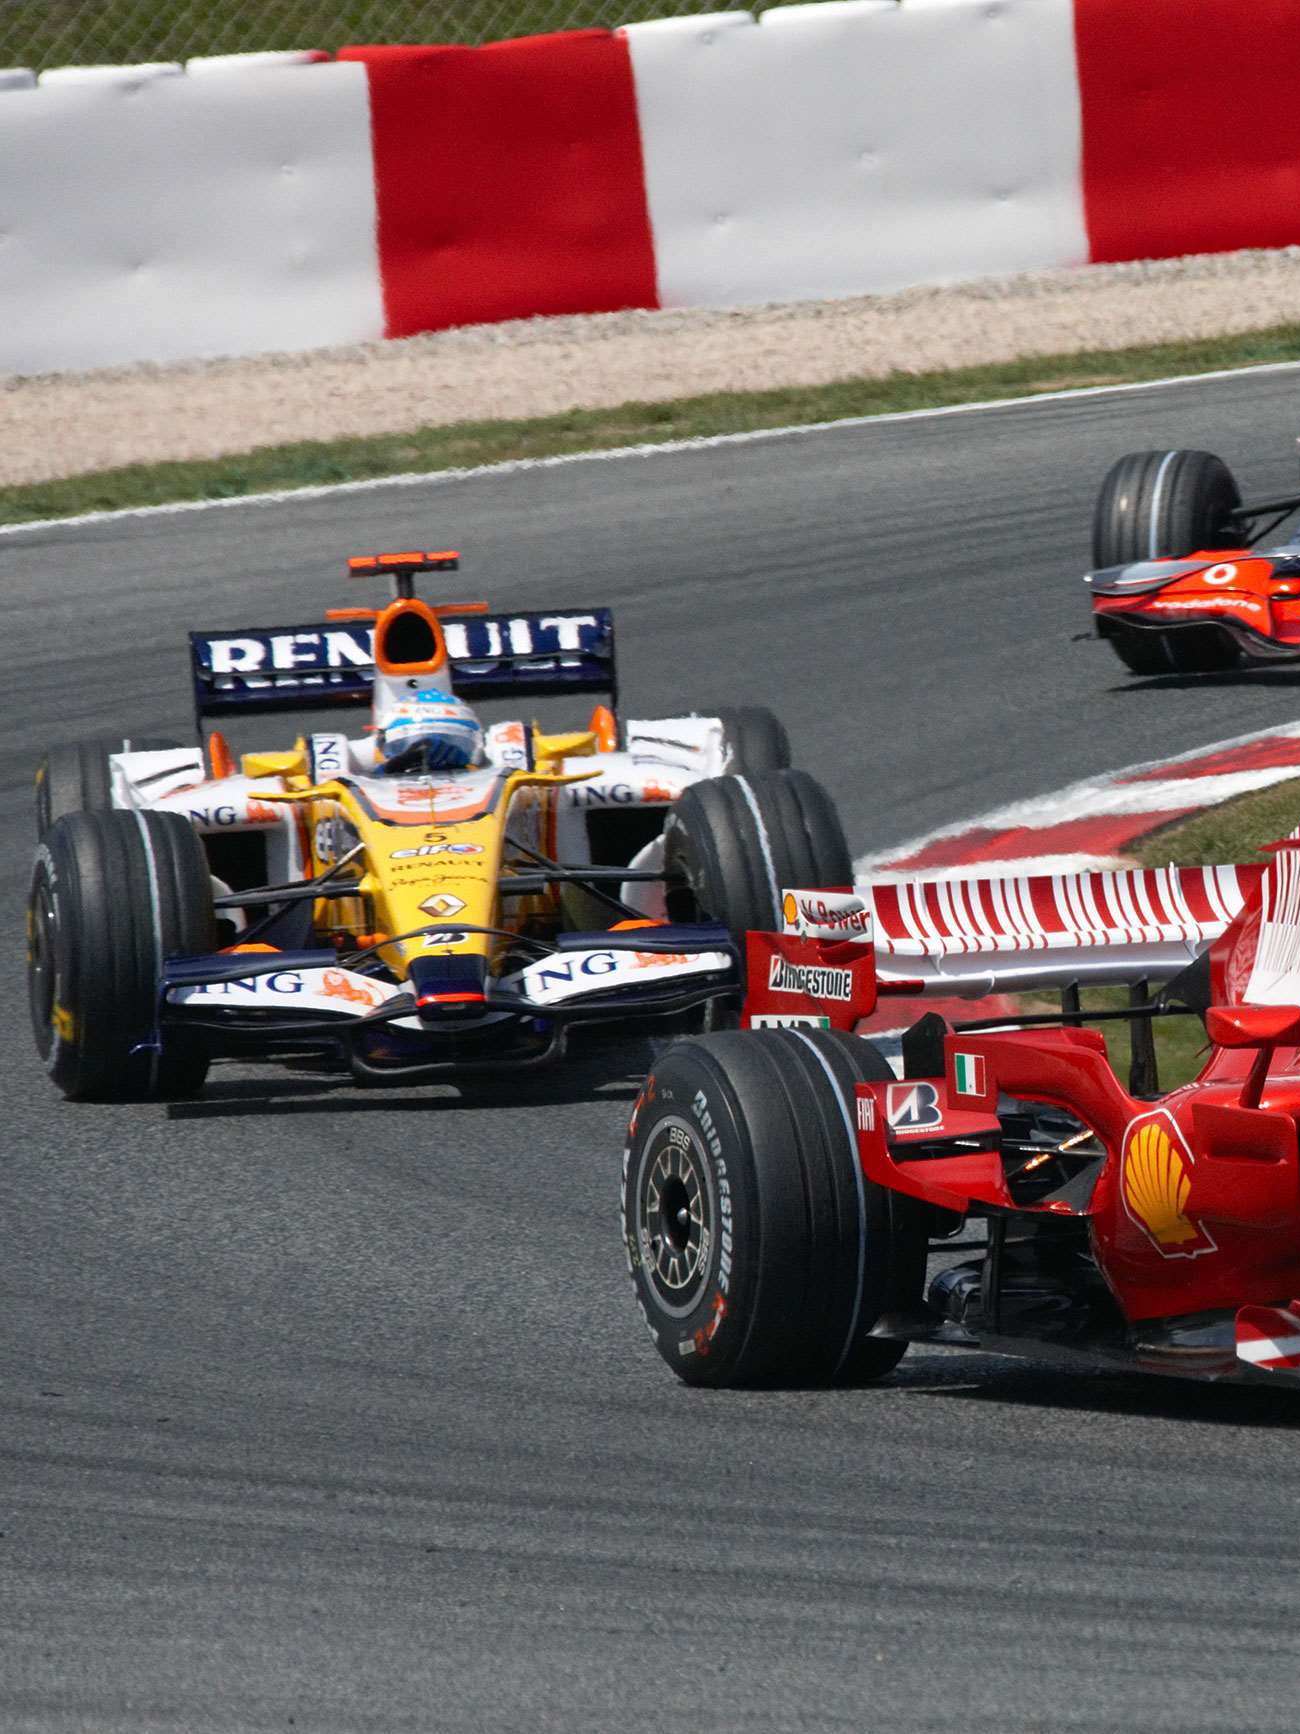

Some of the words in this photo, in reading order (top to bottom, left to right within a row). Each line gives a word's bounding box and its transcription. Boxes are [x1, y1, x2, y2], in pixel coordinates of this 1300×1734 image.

[206, 615, 598, 690] RENULT
[571, 783, 633, 807] ING
[188, 805, 238, 827] NG
[770, 958, 852, 998] BRIDGESTONE
[669, 1127, 691, 1151] BBS
[691, 1089, 733, 1294] BRIDGESTONE
